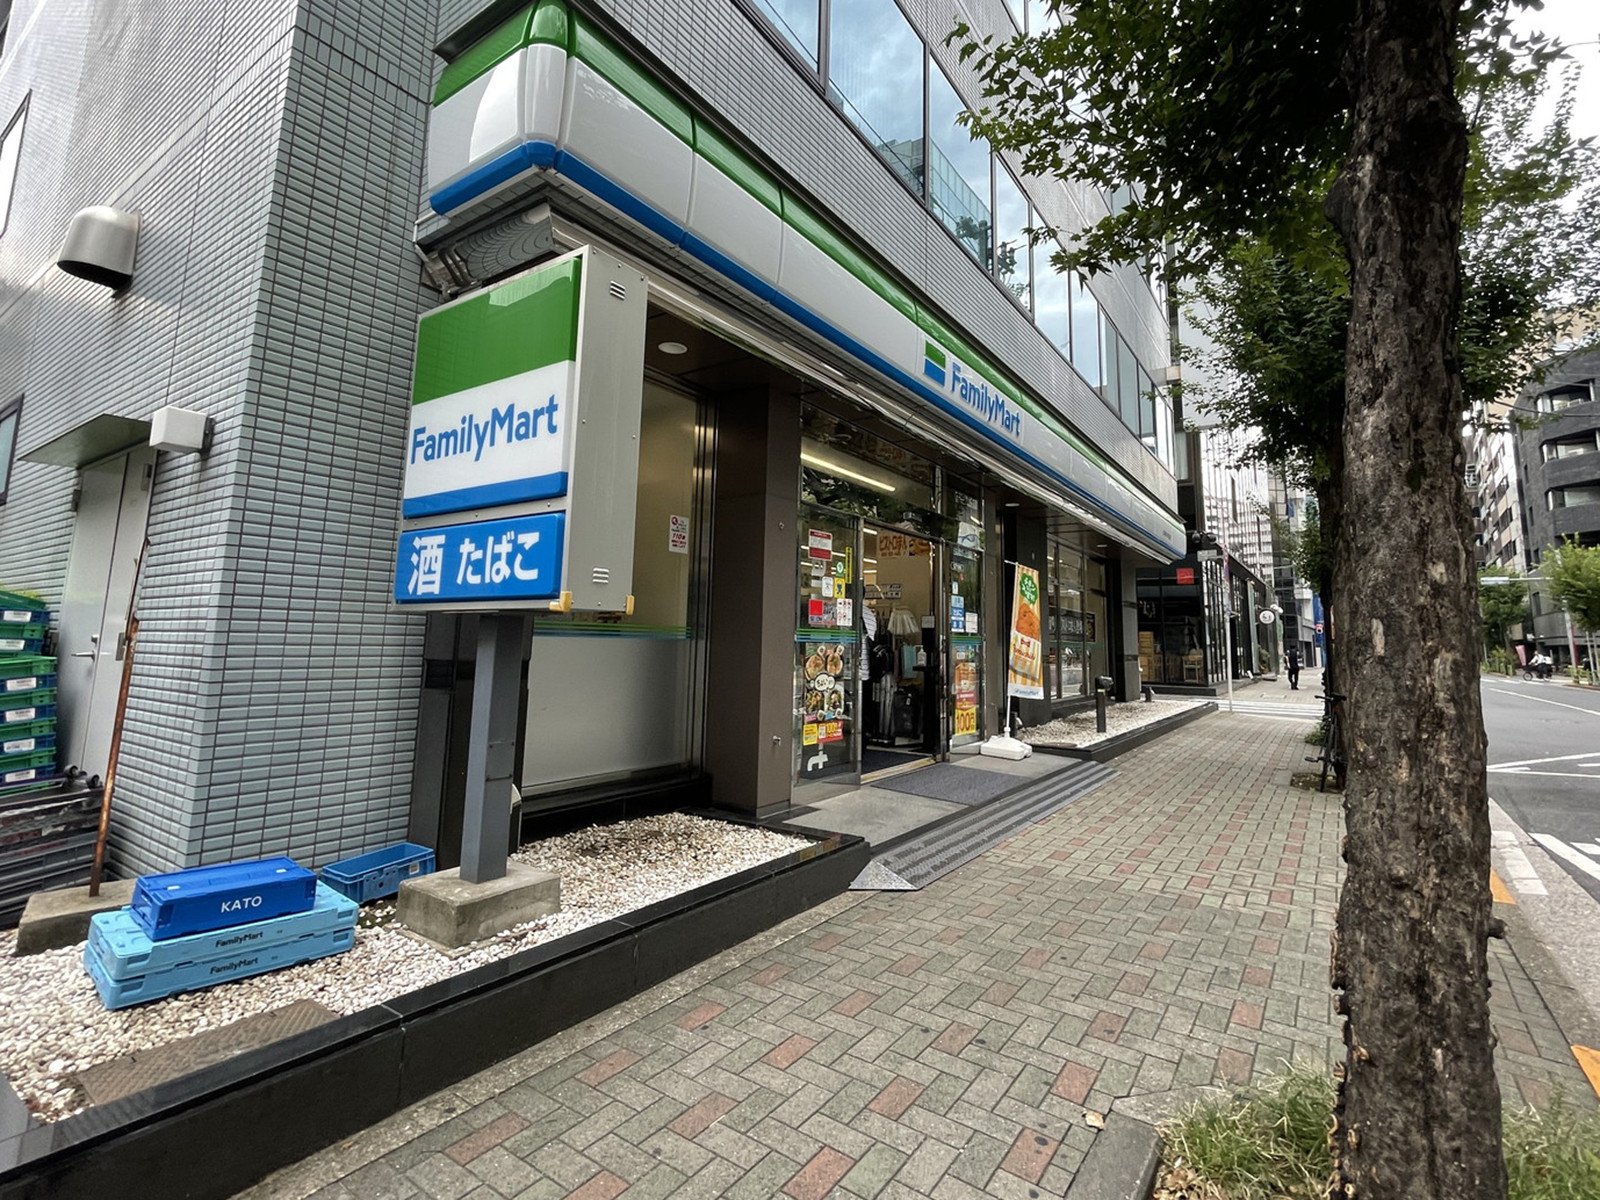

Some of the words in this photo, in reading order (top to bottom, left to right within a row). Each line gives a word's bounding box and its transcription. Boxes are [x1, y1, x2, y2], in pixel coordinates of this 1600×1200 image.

[951, 362, 1021, 437] FamilyMart
[411, 394, 558, 464] FamilyMart
[408, 534, 446, 595] 酒
[456, 530, 540, 585] たばこ
[221, 896, 262, 913] KATO
[216, 932, 263, 947] FamilyMart
[210, 957, 258, 974] FamilyMart
